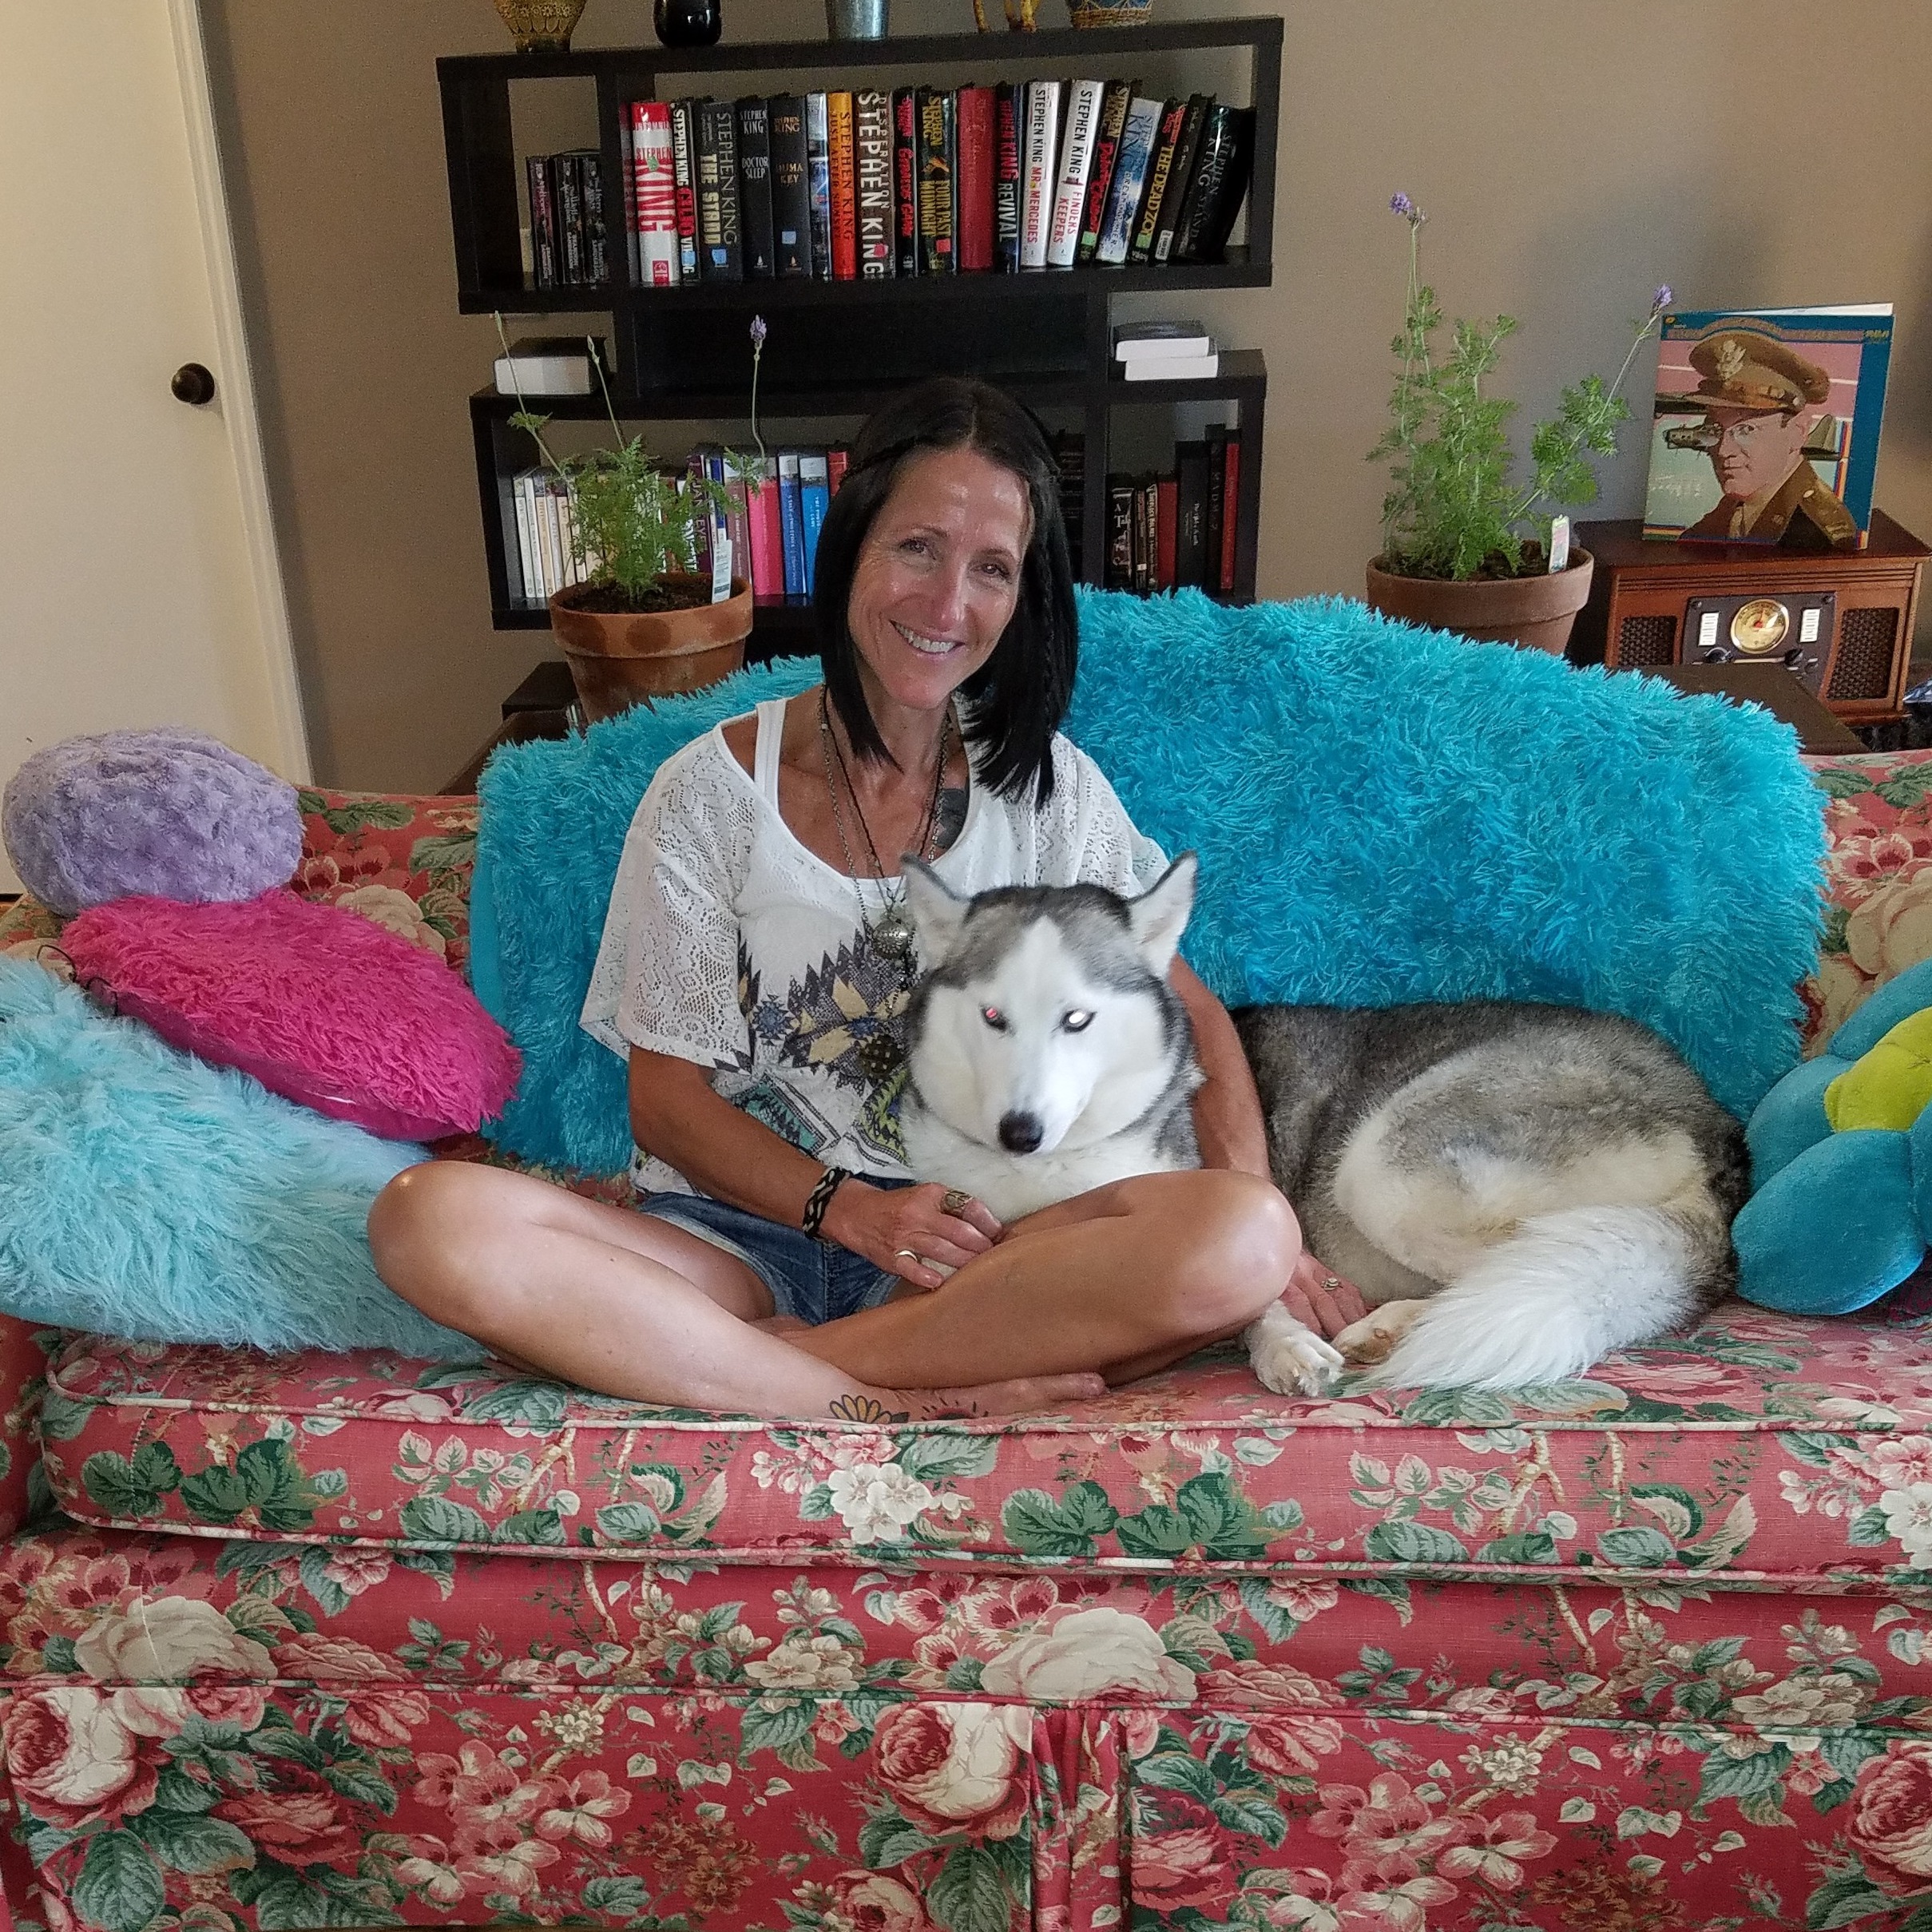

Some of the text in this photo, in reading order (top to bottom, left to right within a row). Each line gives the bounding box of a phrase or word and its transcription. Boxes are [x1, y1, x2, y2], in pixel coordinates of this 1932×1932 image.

[740, 109, 768, 120] STEPHEN
[744, 120, 764, 134] KING
[922, 105, 932, 139] KING
[928, 96, 943, 147] STEPHEN
[1032, 89, 1045, 163] STEPHEN KING
[1069, 89, 1093, 174] STEPHEN KING
[636, 147, 672, 161] STEPHEN
[673, 109, 689, 186] STEPHEN KING
[700, 153, 717, 184] THE
[742, 157, 768, 169] DOCTOR
[878, 96, 890, 209] DESPERATION
[1001, 141, 1019, 181] KING
[1158, 146, 1174, 171] THE
[1209, 134, 1232, 196] STEPHEN
[635, 157, 677, 232] KING
[717, 113, 737, 245] STEPHEN KING
[744, 168, 766, 180] SLEEP
[840, 112, 853, 241] STEPHEN KING
[858, 92, 885, 275] STEPHEN KING
[1147, 173, 1168, 213] DEAD
[702, 192, 721, 244] STAND
[919, 180, 936, 237] MIDNIGHT
[936, 210, 950, 237] PAST
[998, 183, 1018, 243] REVIVAL
[1027, 190, 1041, 244] MERCEDES
[1053, 196, 1069, 244] KEEPERS
[1067, 192, 1082, 235] FINDERS
[1141, 212, 1158, 235] ZO
[692, 479, 708, 554] JAN EYR
